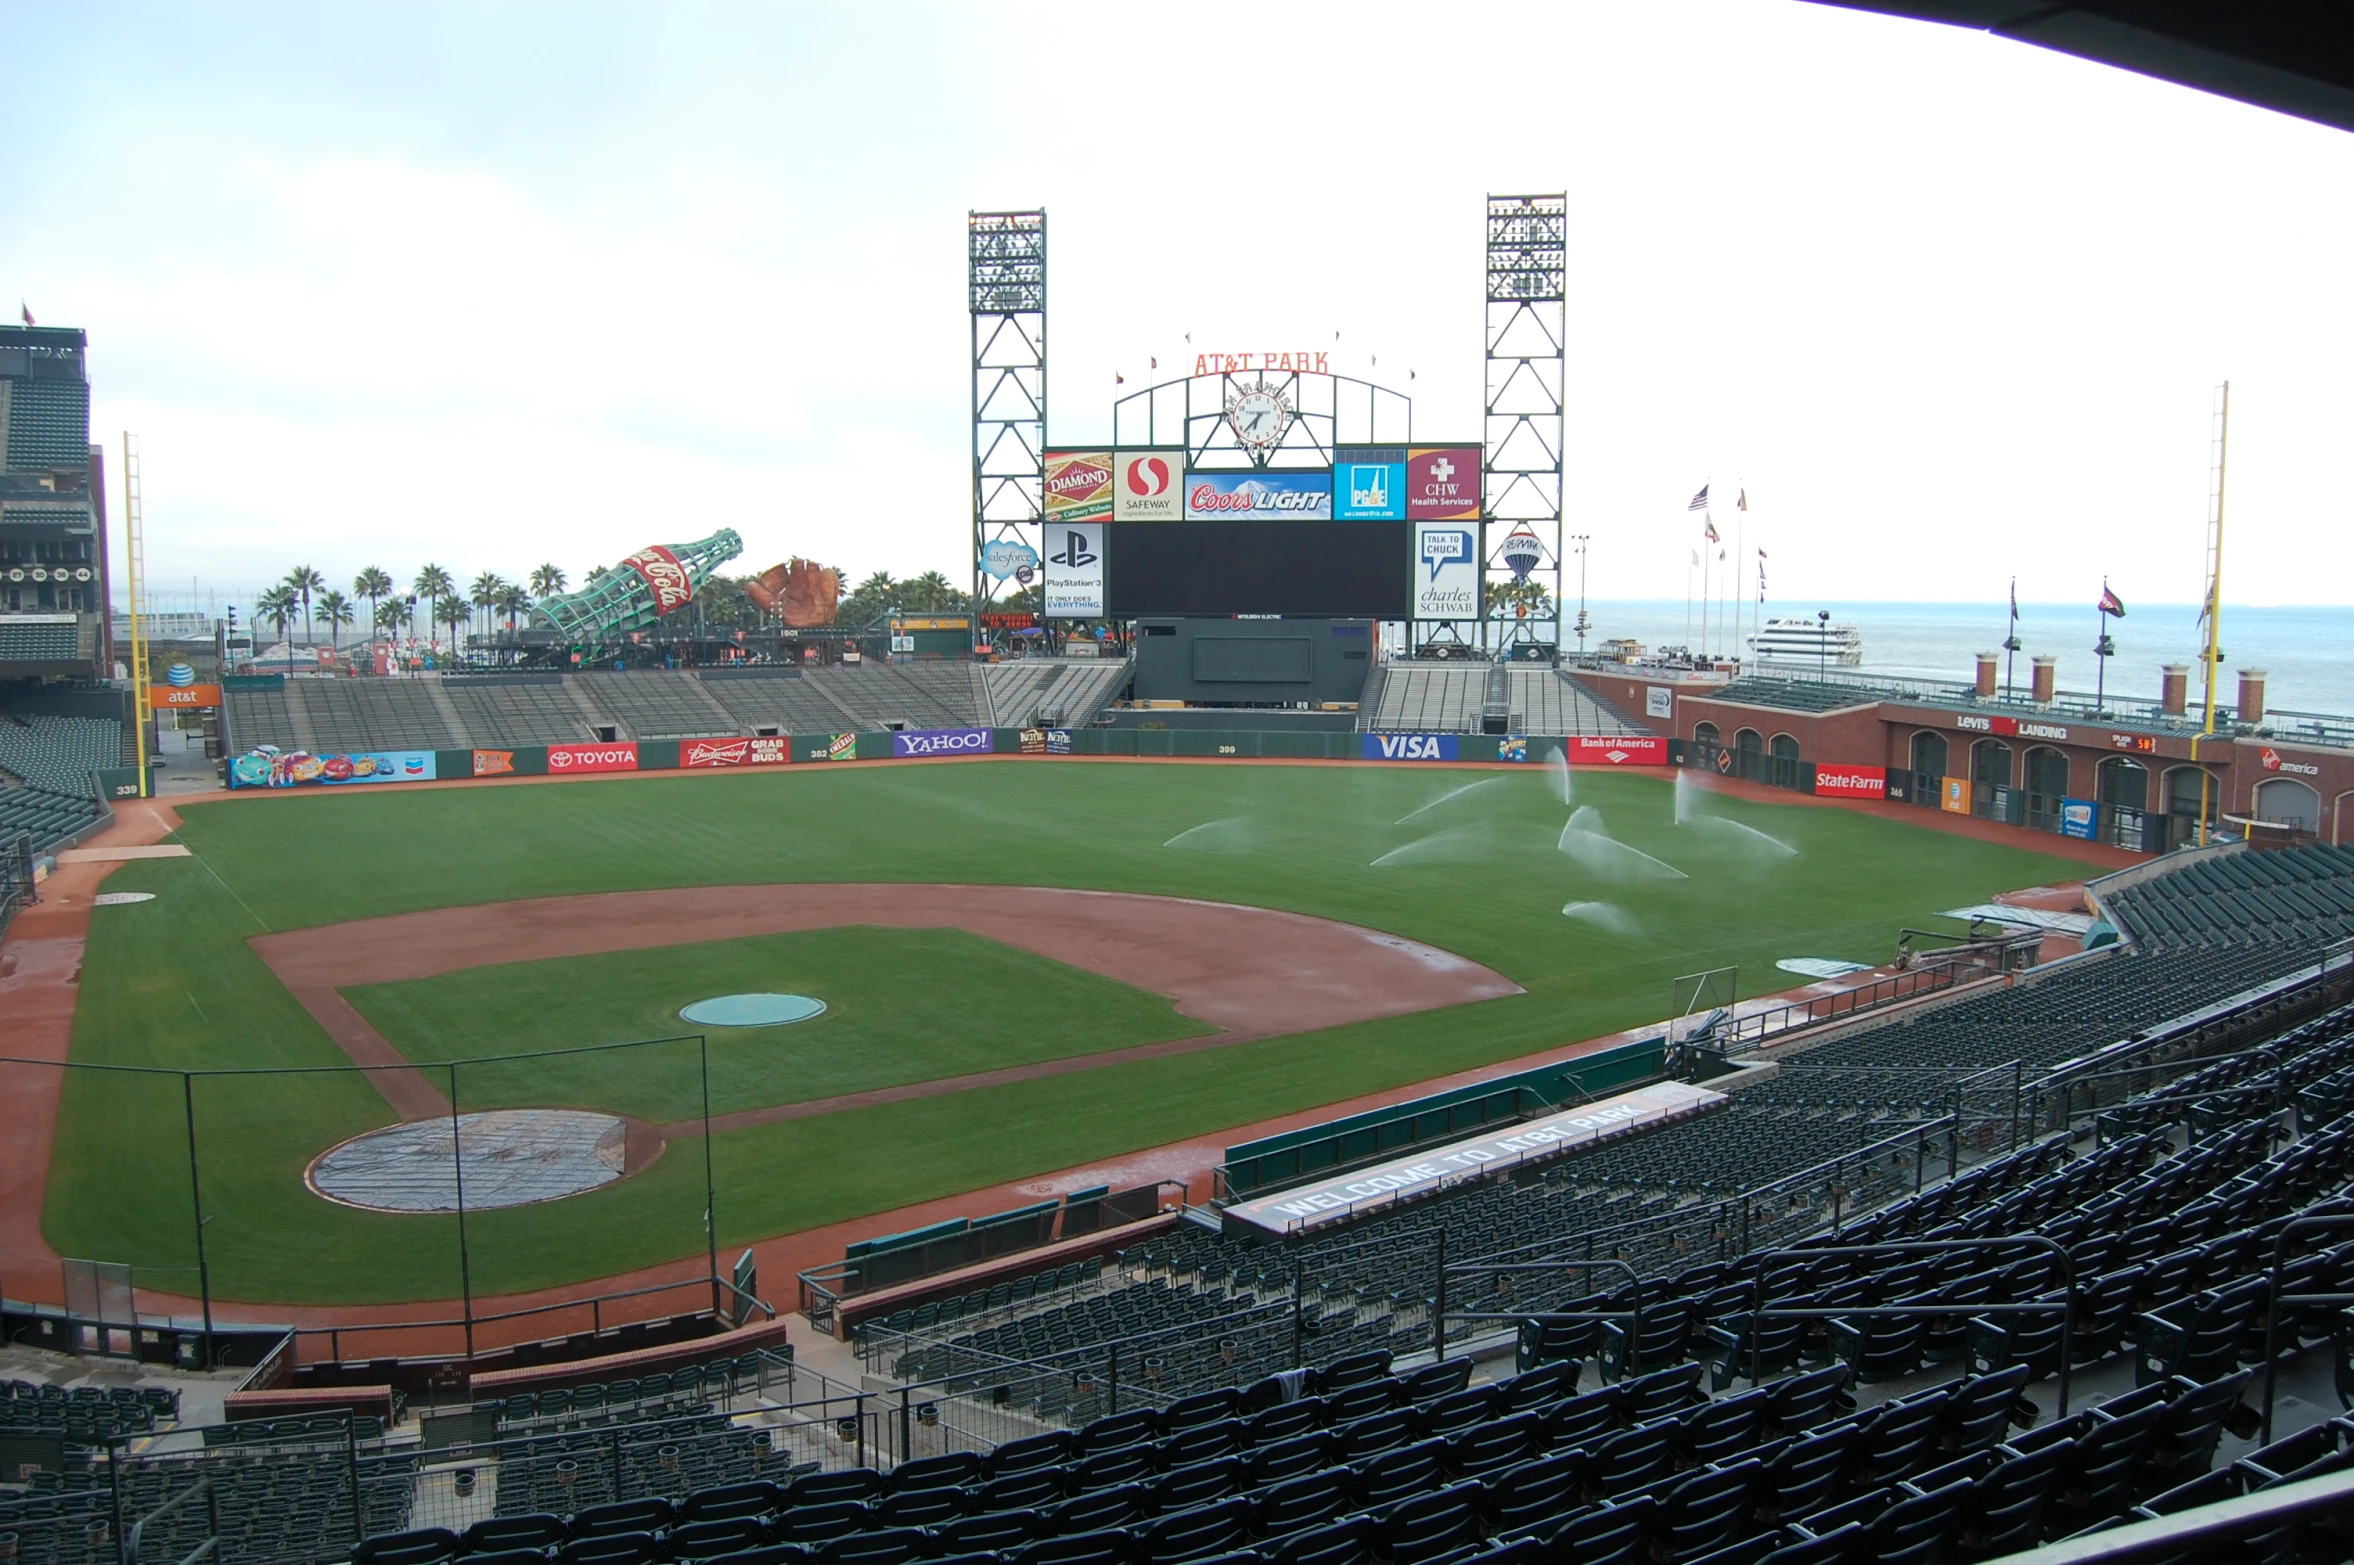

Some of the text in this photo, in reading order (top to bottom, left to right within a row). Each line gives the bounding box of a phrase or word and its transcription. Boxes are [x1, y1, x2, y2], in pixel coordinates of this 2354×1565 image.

[1193, 352, 1329, 378] AT&T PARK
[1050, 470, 1108, 493] DIAMOND
[1425, 483, 1460, 496] CHW
[1190, 484, 1326, 512] Coors LIGHT
[1353, 489, 1386, 505] PG&E
[1411, 497, 1473, 506] Health Services
[1126, 500, 1170, 509] SAFEWAY
[1063, 509, 1089, 518] Culinary
[1427, 535, 1459, 543] TALK TO
[1427, 544, 1459, 554] CHUCK
[1506, 540, 1539, 551] RE/MAX
[986, 550, 1033, 568] salesforce
[1046, 579, 1092, 588] PlayStation
[1421, 586, 1472, 602] charles
[1420, 602, 1472, 613] SCHWAB
[168, 690, 197, 703] at&t
[2019, 723, 2067, 739] LANDING
[751, 739, 784, 749] GRAB
[829, 733, 856, 754] EMERALD
[898, 731, 987, 754] YAHOO!
[1376, 737, 1440, 758] VISA
[1581, 738, 1655, 748] Bank of America
[688, 748, 747, 760] Budweiser
[811, 750, 827, 758] 382
[1219, 745, 1236, 754] 399
[575, 750, 635, 764] TOYOTA
[752, 752, 784, 762] BUDS
[2280, 762, 2318, 775] america
[1816, 773, 1885, 789] State Farm
[117, 785, 137, 795] 339
[1890, 787, 1903, 797] 365
[1273, 1104, 1649, 1217] WELCOME TO AT&T PARK
